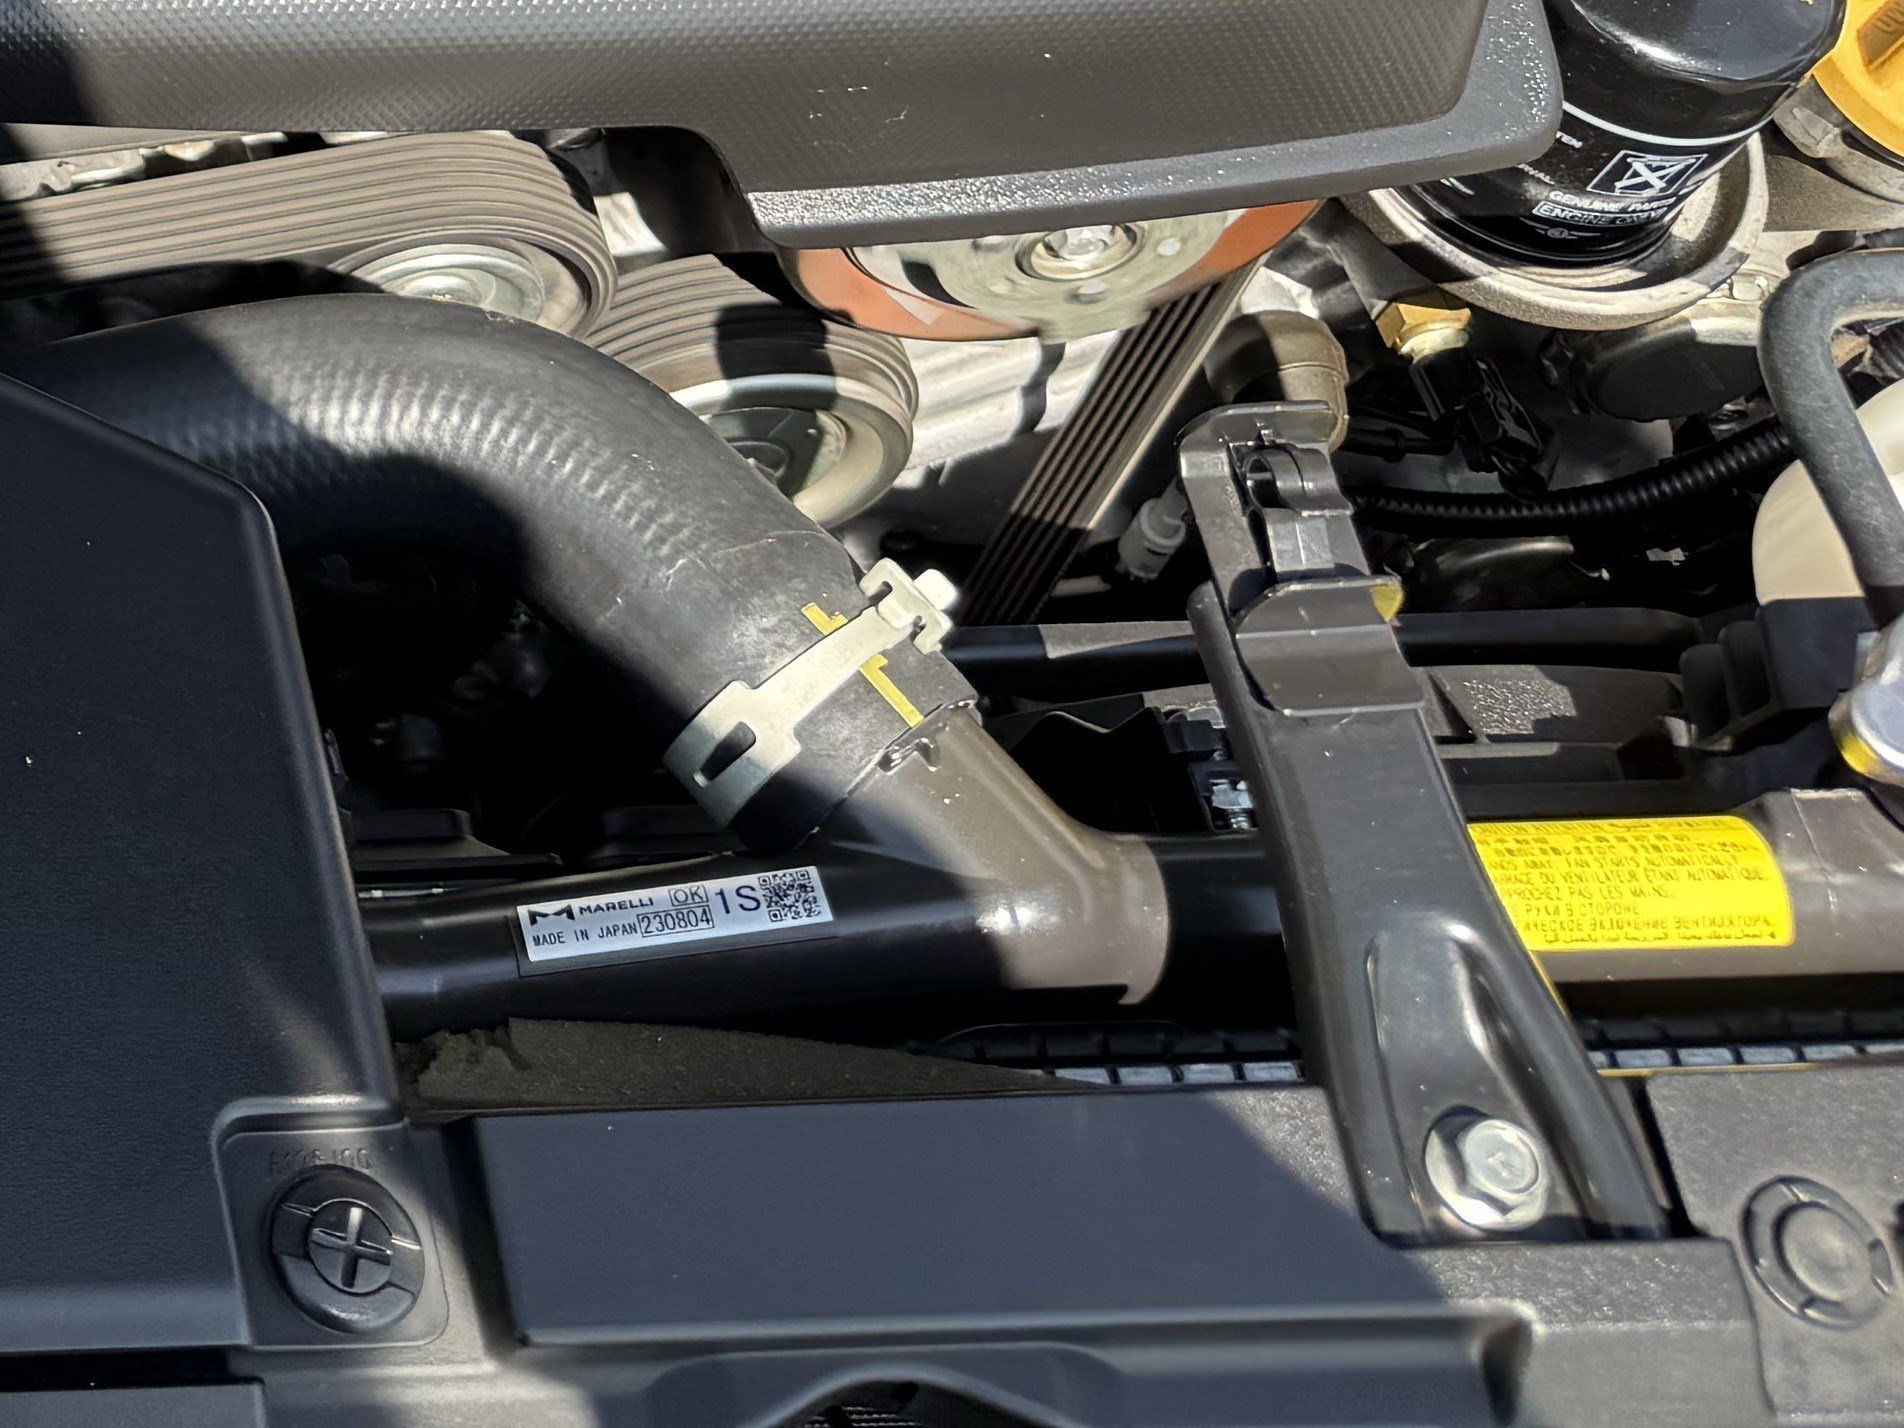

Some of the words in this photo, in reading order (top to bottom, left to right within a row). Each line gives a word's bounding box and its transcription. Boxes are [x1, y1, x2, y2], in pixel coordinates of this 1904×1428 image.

[1549, 190, 1621, 211] GENUINE
[578, 896, 654, 914] MARELLI
[672, 885, 705, 904] OK
[714, 884, 762, 915] 1S
[532, 930, 566, 947] MADE
[573, 929, 590, 943] IN
[597, 922, 638, 940] JAPAN
[640, 907, 712, 935] 230804
